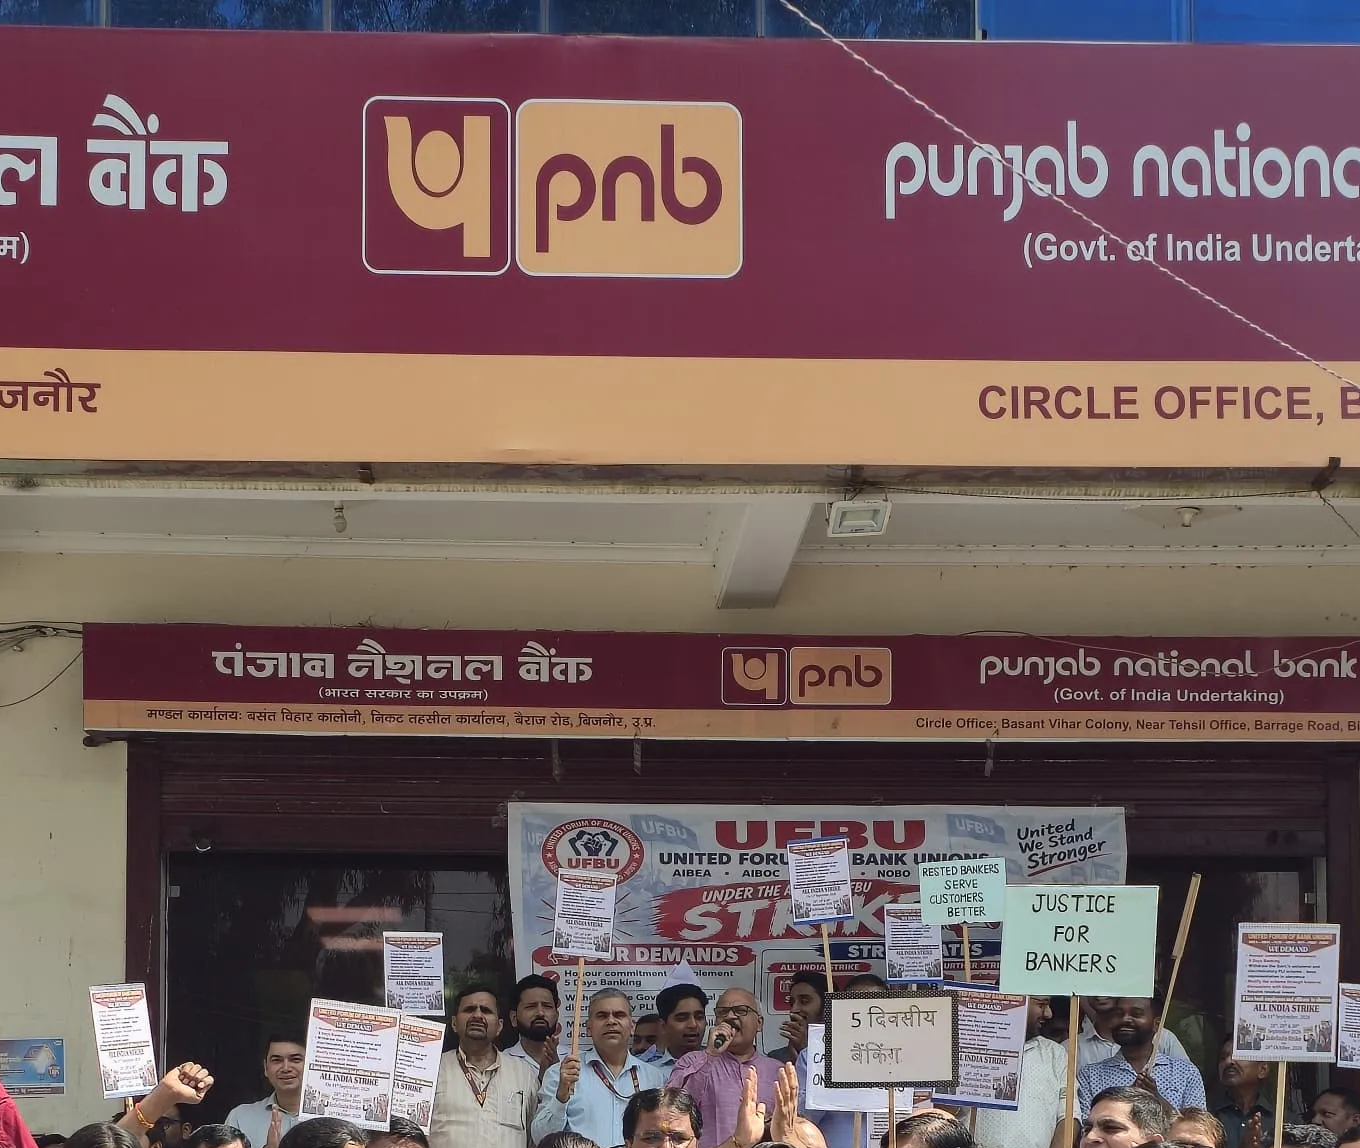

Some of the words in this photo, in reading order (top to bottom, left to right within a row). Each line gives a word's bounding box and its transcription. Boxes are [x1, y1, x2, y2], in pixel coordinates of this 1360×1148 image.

[88, 93, 229, 213] बैंक
[886, 121, 1108, 222] punjab
[535, 123, 722, 254] pnb
[1023, 233, 1118, 269] (Govt.
[1127, 233, 1158, 262] of
[1166, 233, 1240, 263] India
[977, 385, 1140, 420] CIRCLE
[1153, 385, 1325, 427] OFFICE,
[212, 643, 335, 680] पंजाब
[348, 638, 503, 685] नैशनल
[518, 641, 594, 683] बैंक
[980, 648, 1101, 685] punjab
[1114, 650, 1258, 678] national
[1272, 649, 1358, 679] bank
[798, 654, 883, 698] pnb
[318, 686, 360, 701] (भारत
[365, 687, 413, 700] सरकार
[417, 688, 434, 700] का
[438, 687, 488, 702] उपक्रम)
[1053, 687, 1105, 705] (Govt.
[1110, 688, 1126, 702] of
[1131, 688, 1172, 702] India
[1177, 688, 1285, 706] Undertaking)
[147, 709, 183, 720] मण्डल
[247, 708, 276, 721] बसंत
[281, 708, 313, 722] विहार
[317, 709, 366, 725] कालोनी,
[370, 709, 404, 724] निकट
[408, 711, 451, 725] तहसील
[456, 711, 509, 727] कार्यालय,
[514, 711, 546, 725] बैराज
[551, 712, 574, 728] रोड,
[578, 712, 628, 729] बिजनौर,
[916, 717, 952, 729] Circle
[956, 717, 997, 729] Office:
[1001, 718, 1044, 729] Basant
[1048, 718, 1081, 729] Vihar
[1085, 718, 1131, 732] Colony,
[1136, 719, 1166, 730] Near
[1169, 720, 1206, 730] Tehsil
[1209, 720, 1250, 732] Office,
[1254, 720, 1304, 733] Barrage
[1308, 721, 1343, 732] Road,
[715, 820, 926, 850] UFBU
[1017, 818, 1075, 842] United
[1019, 838, 1046, 854] We
[1048, 828, 1093, 849] Stand
[660, 853, 731, 865] UNITED
[739, 853, 789, 865] FORU
[852, 853, 907, 866] BANK
[1027, 839, 1108, 868] Stronger
[568, 858, 619, 868] UFBU
[922, 865, 958, 877] RESTED
[960, 863, 1000, 875] BANKERS
[672, 869, 712, 878] AIBEA
[742, 869, 780, 878] AIBOC
[944, 879, 978, 890] SERVE
[702, 887, 755, 904] UNDER
[757, 885, 782, 898] THE
[929, 891, 984, 904] CUSTOMERS
[1032, 893, 1116, 913] JUSTICE
[947, 906, 986, 918] BETTER
[1054, 925, 1090, 943] FOR
[636, 947, 739, 962] DEMANDS
[848, 944, 885, 957] STR
[780, 963, 798, 971] ALL
[800, 963, 826, 971] INDIA
[1026, 951, 1117, 973] BANKERS
[611, 969, 667, 977] commitment
[565, 979, 571, 987] 5
[600, 979, 642, 988] Banking
[850, 1012, 861, 1028] 5
[867, 1005, 938, 1028] दिवसीय
[1254, 1003, 1267, 1012] ALL
[1268, 1003, 1290, 1013] INDIA
[1291, 1004, 1320, 1013] STRIKE
[964, 1055, 983, 1063] INDIA
[984, 1056, 1009, 1066] STRIKE
[320, 1072, 333, 1081] ALL
[333, 1074, 353, 1084] INDIA
[353, 1077, 379, 1087] STRIKE
